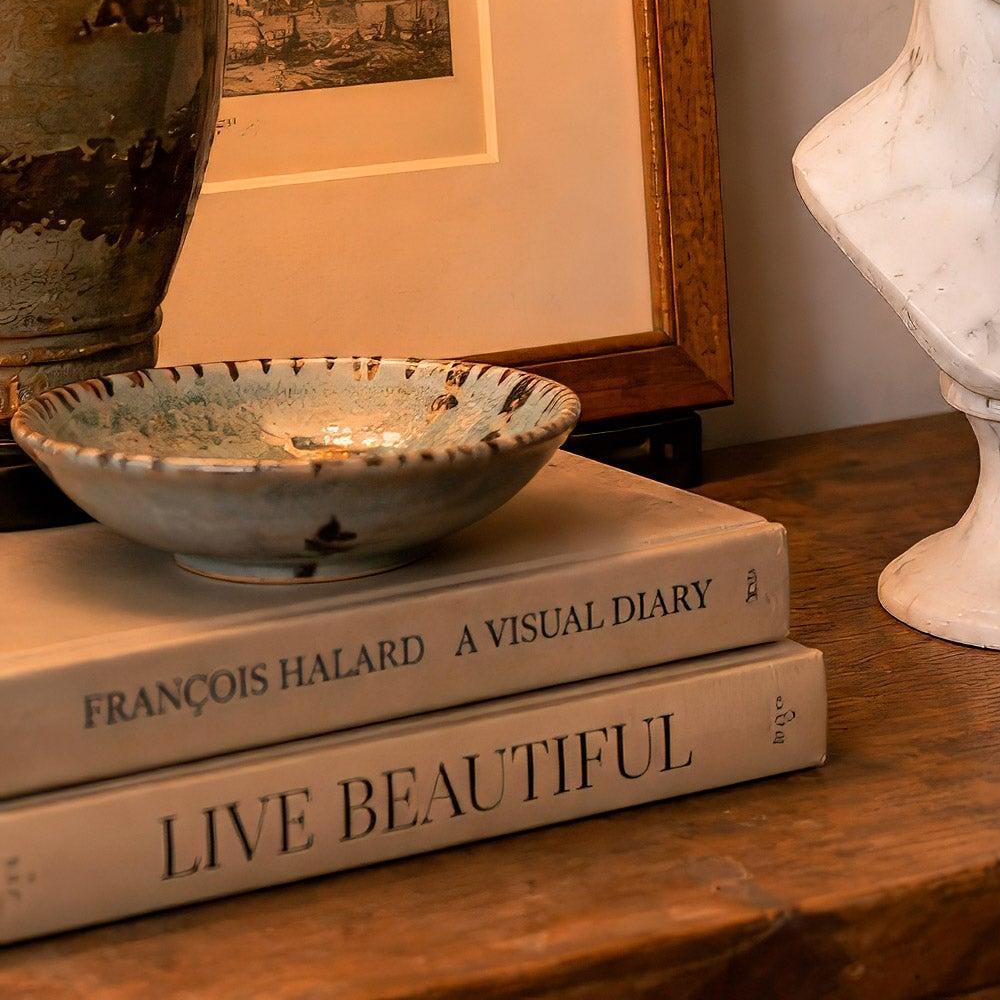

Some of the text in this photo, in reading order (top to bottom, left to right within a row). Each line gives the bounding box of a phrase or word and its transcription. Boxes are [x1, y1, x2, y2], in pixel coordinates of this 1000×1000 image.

[83, 662, 269, 729] FRANÇOIS
[279, 634, 425, 690] HALARD
[454, 624, 478, 657] A
[484, 601, 605, 648] VISUAL
[611, 578, 713, 627] DIARY
[160, 786, 315, 881] LIVE
[337, 712, 694, 844] BEAUTIFUL
